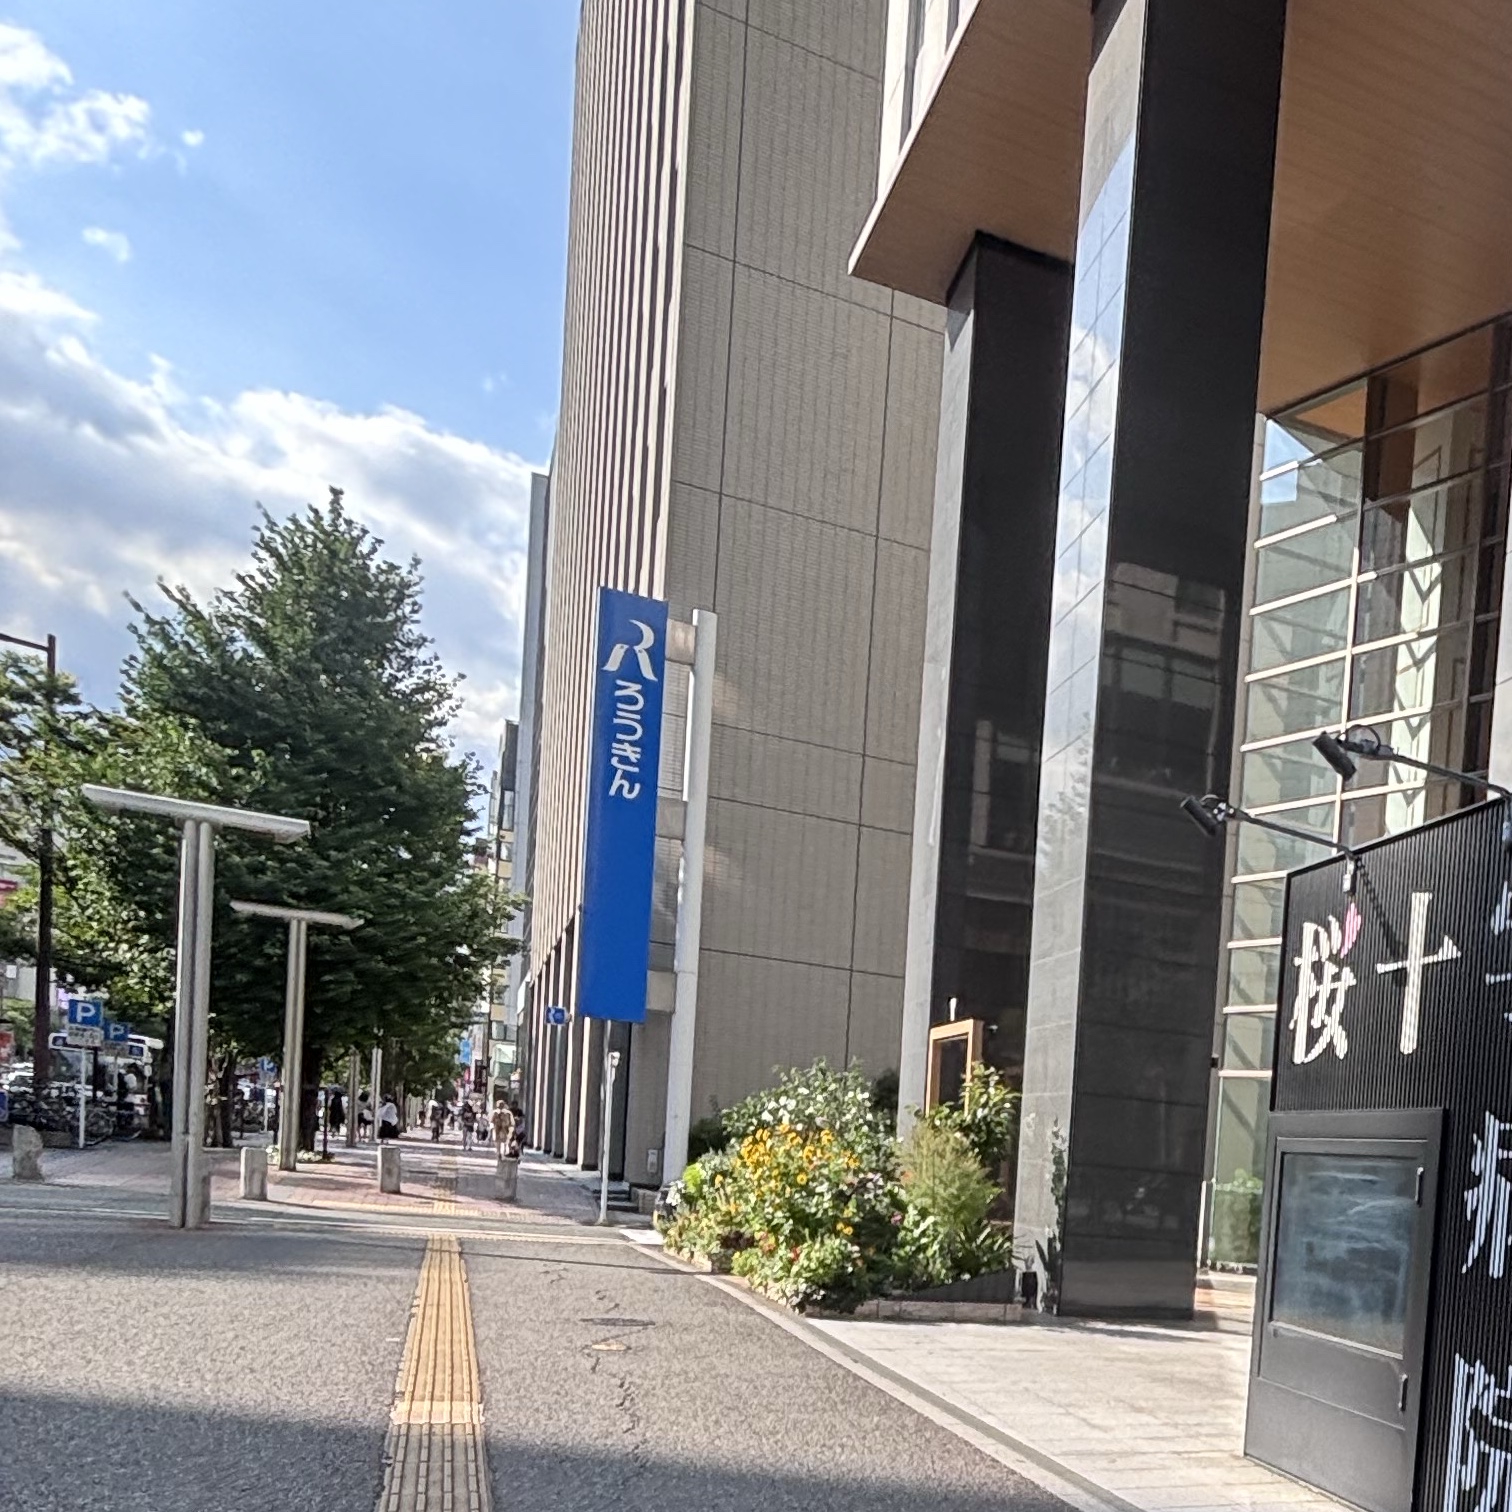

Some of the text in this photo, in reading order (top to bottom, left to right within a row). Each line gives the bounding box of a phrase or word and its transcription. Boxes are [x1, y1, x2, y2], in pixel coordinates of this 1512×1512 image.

[608, 679, 645, 799] ろうきん
[76, 1002, 96, 1023] P
[109, 1024, 124, 1040] P
